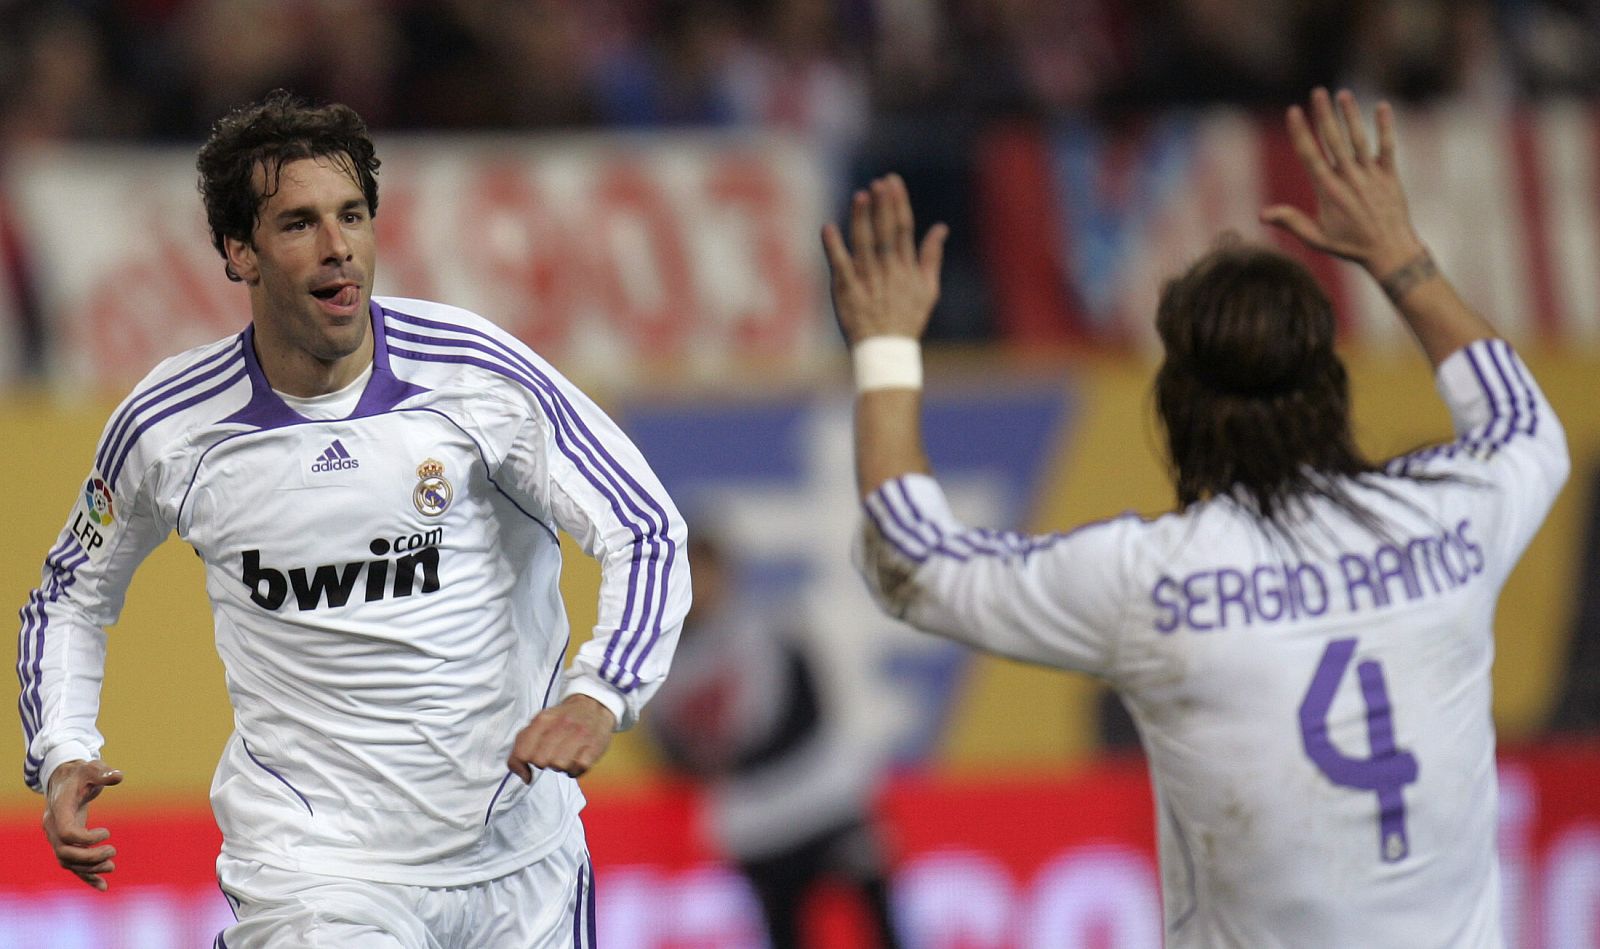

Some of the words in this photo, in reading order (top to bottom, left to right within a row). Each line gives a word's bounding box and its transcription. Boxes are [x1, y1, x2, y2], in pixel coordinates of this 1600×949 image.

[311, 458, 360, 473] adidas
[72, 510, 104, 552] LFP
[241, 538, 441, 611] bwin
[1152, 562, 1330, 635] SERGIO
[1338, 518, 1485, 613] RAMOS
[1299, 636, 1420, 864] 4
